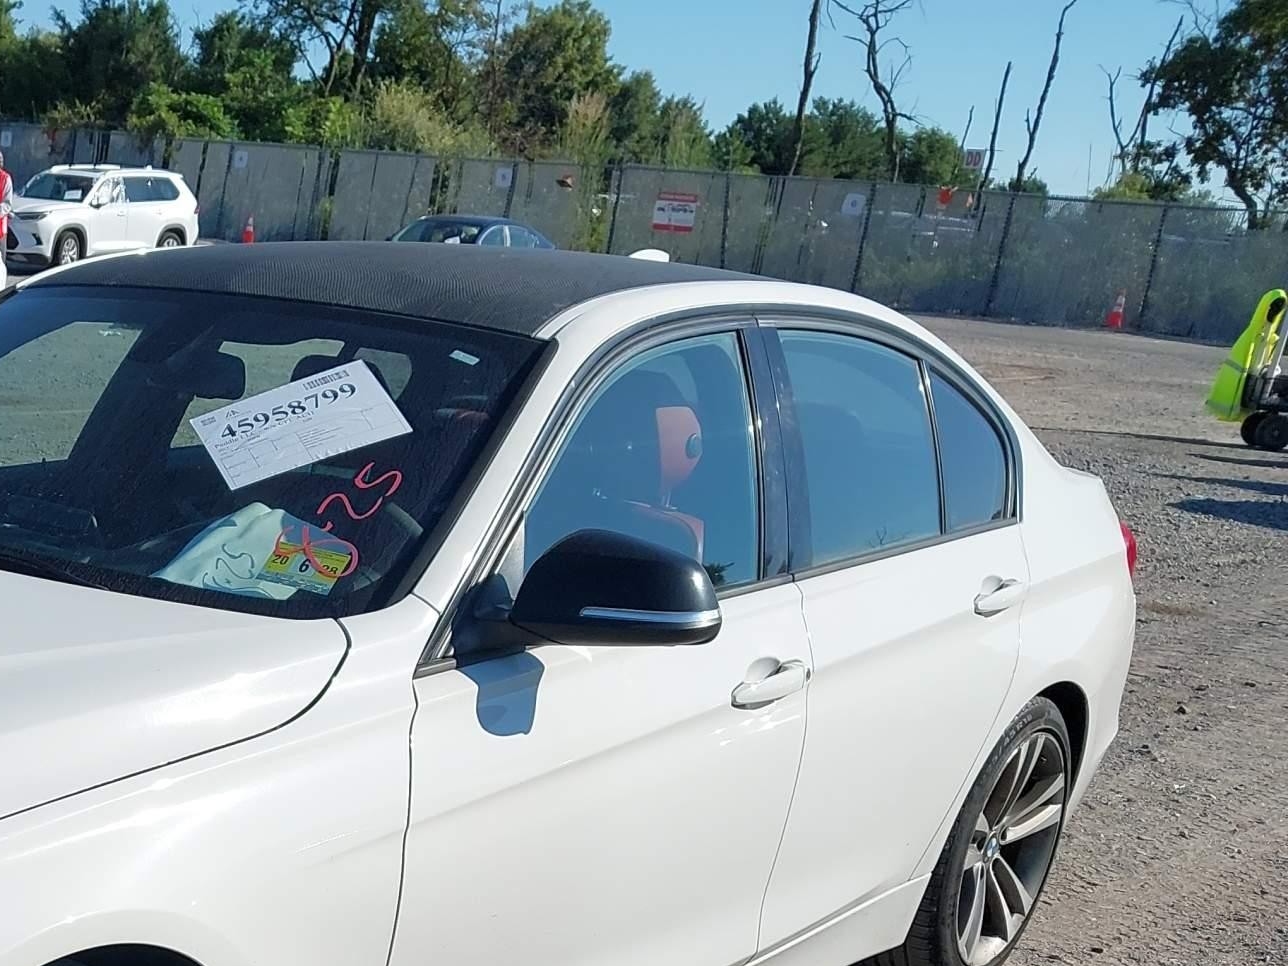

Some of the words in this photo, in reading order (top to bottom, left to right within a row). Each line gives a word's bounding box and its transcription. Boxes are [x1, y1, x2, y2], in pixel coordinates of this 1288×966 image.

[220, 382, 357, 438] 45958799
[272, 554, 289, 565] 20
[298, 558, 311, 573] 6
